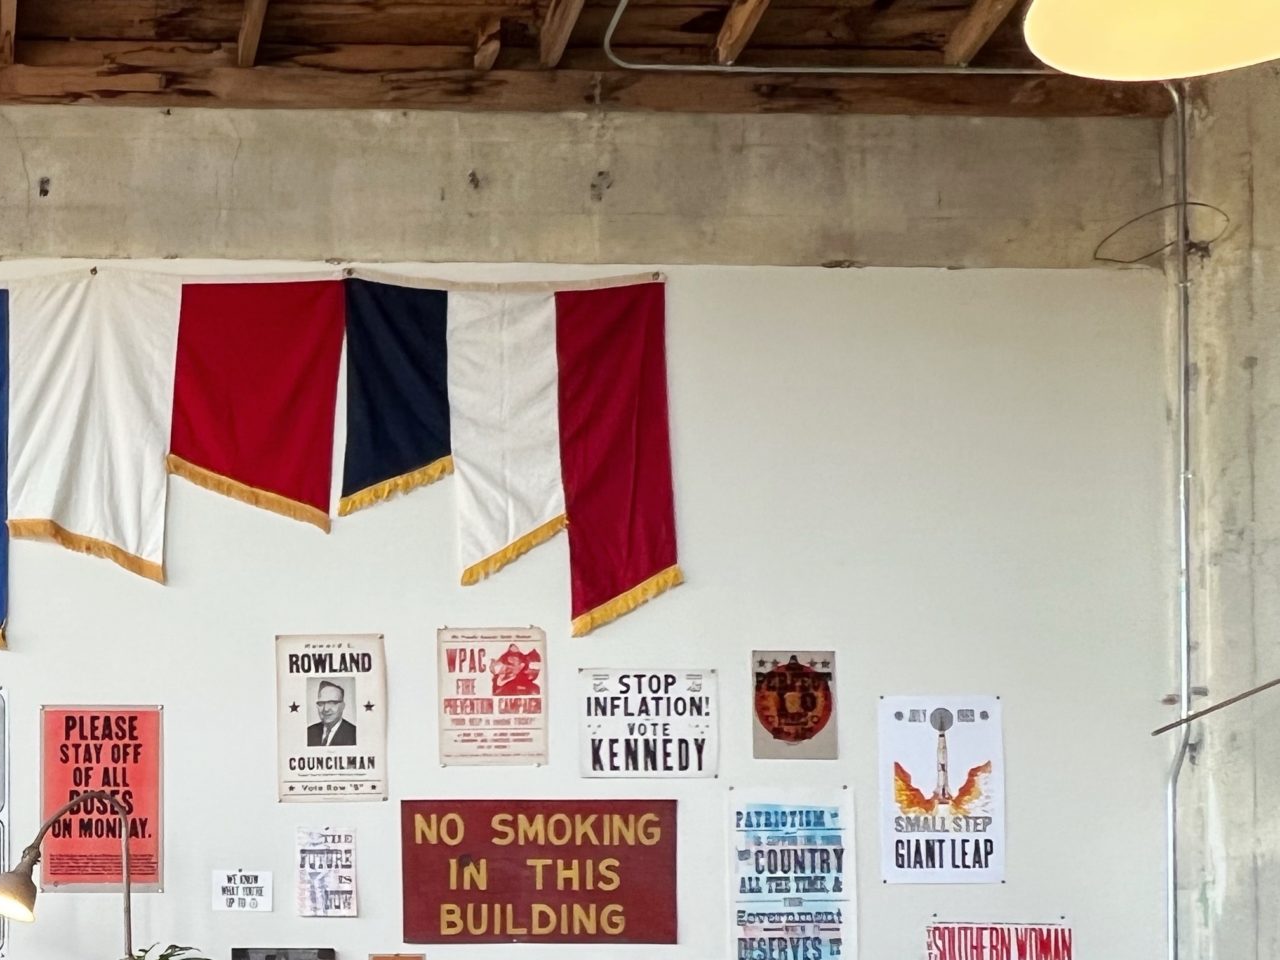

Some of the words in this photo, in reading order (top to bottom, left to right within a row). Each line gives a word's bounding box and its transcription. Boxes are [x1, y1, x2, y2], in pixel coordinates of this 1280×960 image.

[289, 653, 372, 673] ROWLAND
[446, 648, 486, 673] WPAC
[456, 679, 476, 695] FIRE
[619, 674, 677, 694] STOP
[498, 697, 541, 714] CAMPAIGN
[586, 697, 711, 717] INFLATION!
[65, 716, 138, 740] PLEASE
[628, 723, 670, 737] VOTE
[60, 743, 103, 764] STAY
[111, 743, 143, 764] OFF
[289, 756, 375, 770] COUNCILMAN
[591, 738, 706, 772] KENNEDY
[73, 767, 94, 787] OF
[101, 767, 129, 787] ALL
[69, 790, 134, 815] BUSES
[51, 818, 72, 838] ON
[736, 810, 825, 828] PATRIOTISM
[894, 817, 949, 833] SMALL
[953, 816, 993, 833] STEP
[321, 834, 352, 844] THE
[413, 813, 465, 846] NO
[491, 813, 662, 846] SMOKING
[300, 849, 352, 869] FUTURE
[755, 848, 844, 874] COUNTRY
[895, 839, 946, 869] GIANT
[951, 839, 994, 869] LEAP
[227, 874, 237, 885] WE
[240, 874, 258, 884] KNOW
[338, 875, 352, 884] IS
[449, 858, 487, 891] IN
[526, 858, 621, 891] THIS
[740, 876, 762, 893] ALL
[766, 876, 790, 893] THE
[221, 886, 239, 896] WHAT
[226, 897, 235, 908] UP
[238, 897, 246, 908] TO
[440, 903, 626, 936] BUILDING
